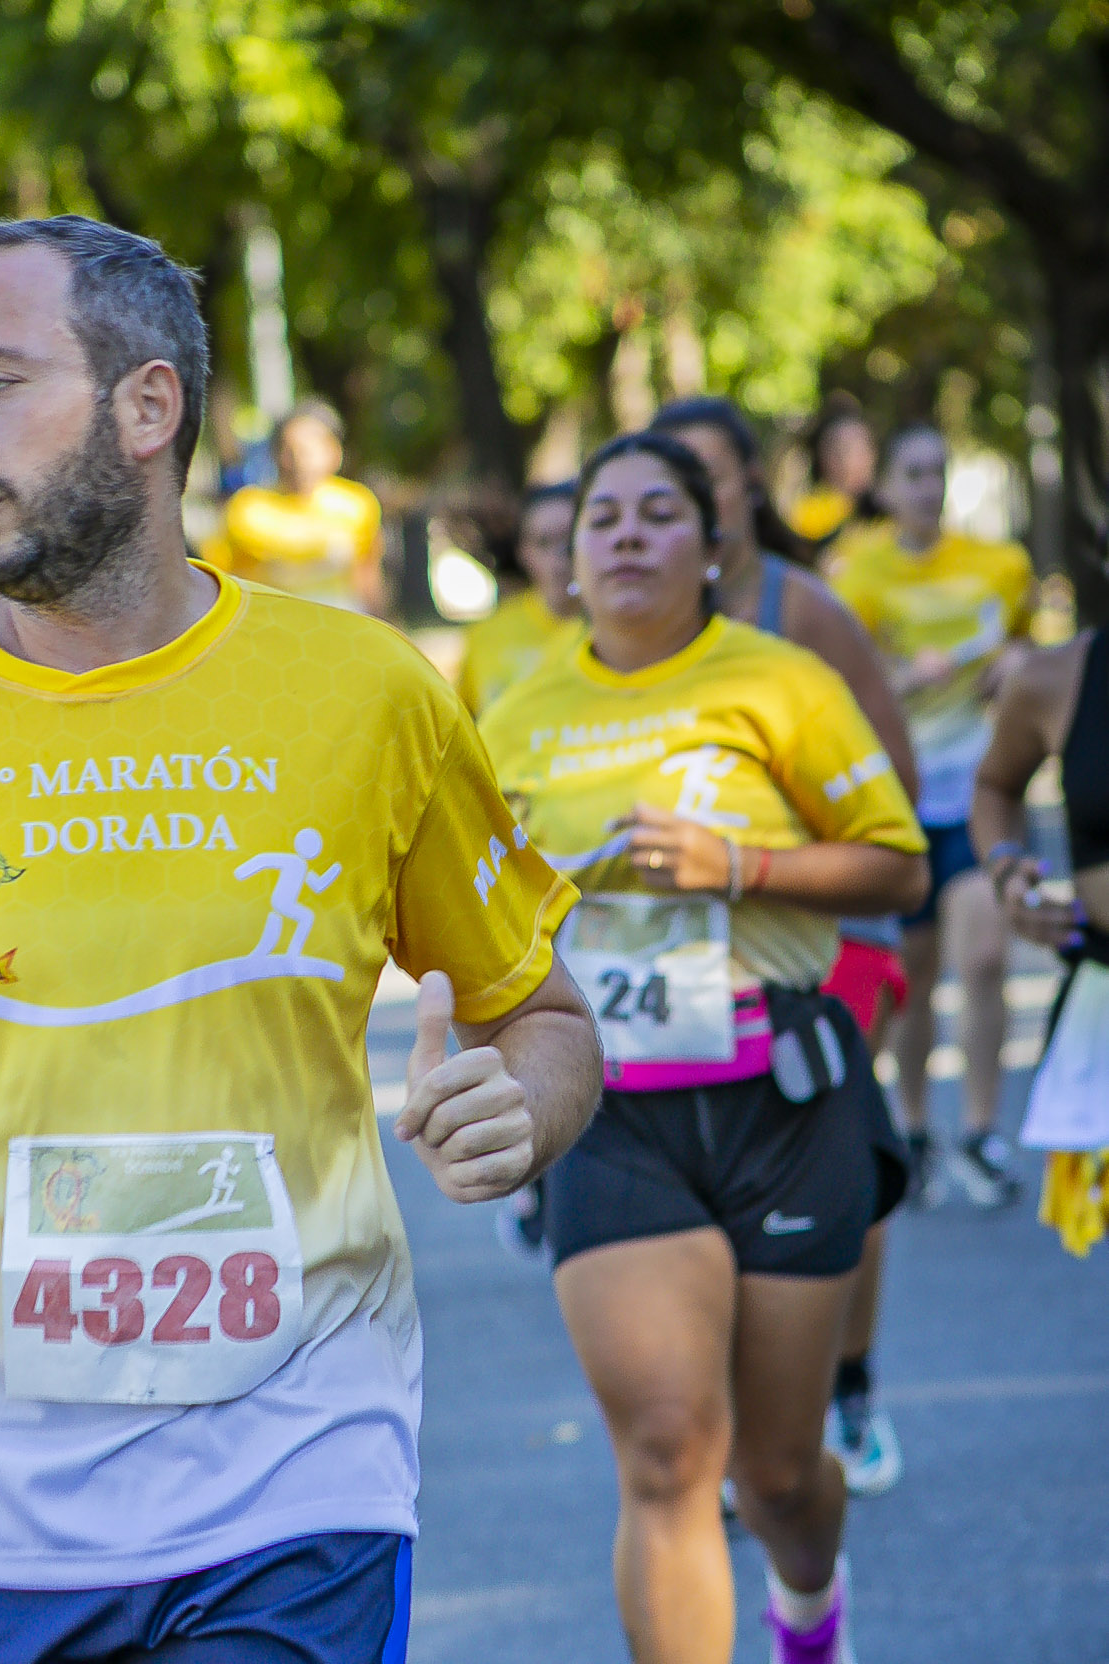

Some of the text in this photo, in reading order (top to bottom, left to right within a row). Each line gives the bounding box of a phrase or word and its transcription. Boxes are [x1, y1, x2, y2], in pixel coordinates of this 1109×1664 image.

[28, 745, 278, 798] MARATÓN
[21, 813, 239, 857] DORADA
[12, 1251, 281, 1347] 4328
